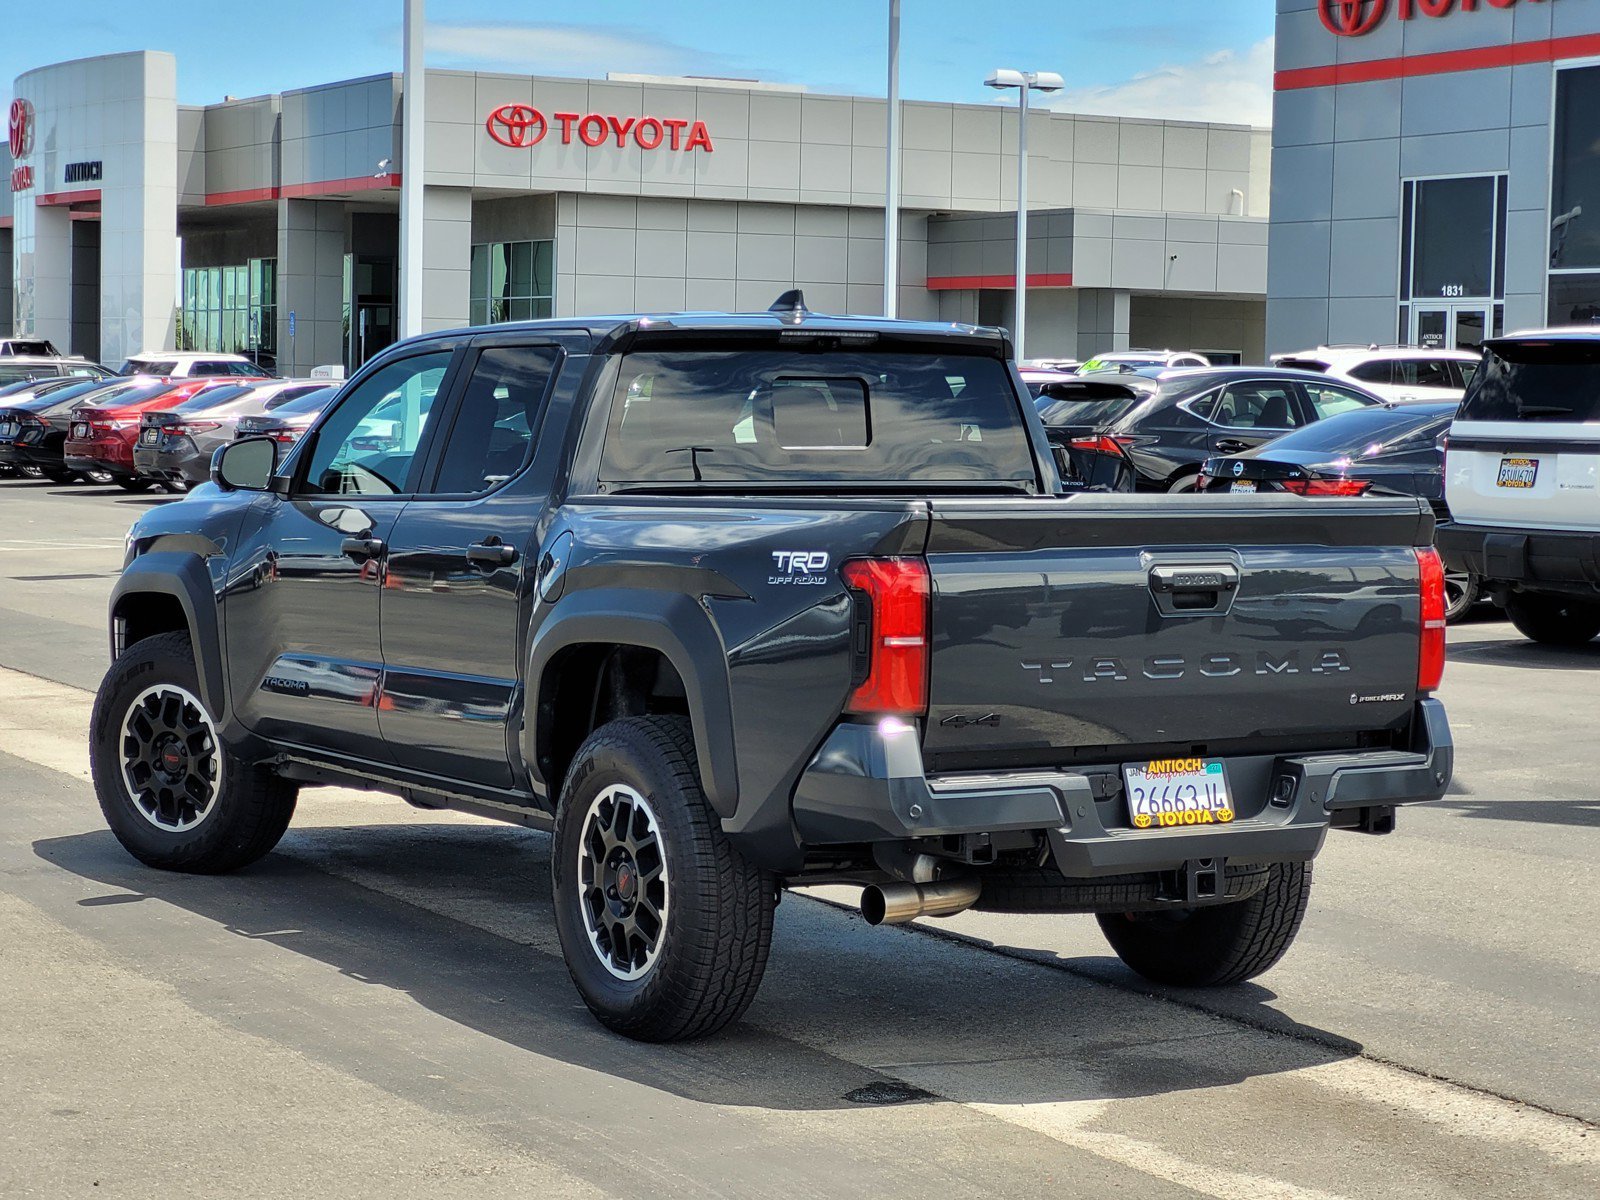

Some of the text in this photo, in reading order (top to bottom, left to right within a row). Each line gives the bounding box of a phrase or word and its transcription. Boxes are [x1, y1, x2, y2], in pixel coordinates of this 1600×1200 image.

[554, 112, 714, 152] TOYOTA
[64, 161, 103, 183] ANTIOCH
[1441, 286, 1463, 296] 1831
[772, 551, 830, 576] TRD
[767, 576, 828, 585] OFF ROAD
[1176, 574, 1219, 586] TOYOTA
[1020, 648, 1351, 684] TACOMA
[265, 677, 306, 690] TACOMA
[1148, 759, 1201, 774] ANTIOCH
[1134, 783, 1225, 815] 26663J4
[1157, 810, 1213, 826] TOYOTA
